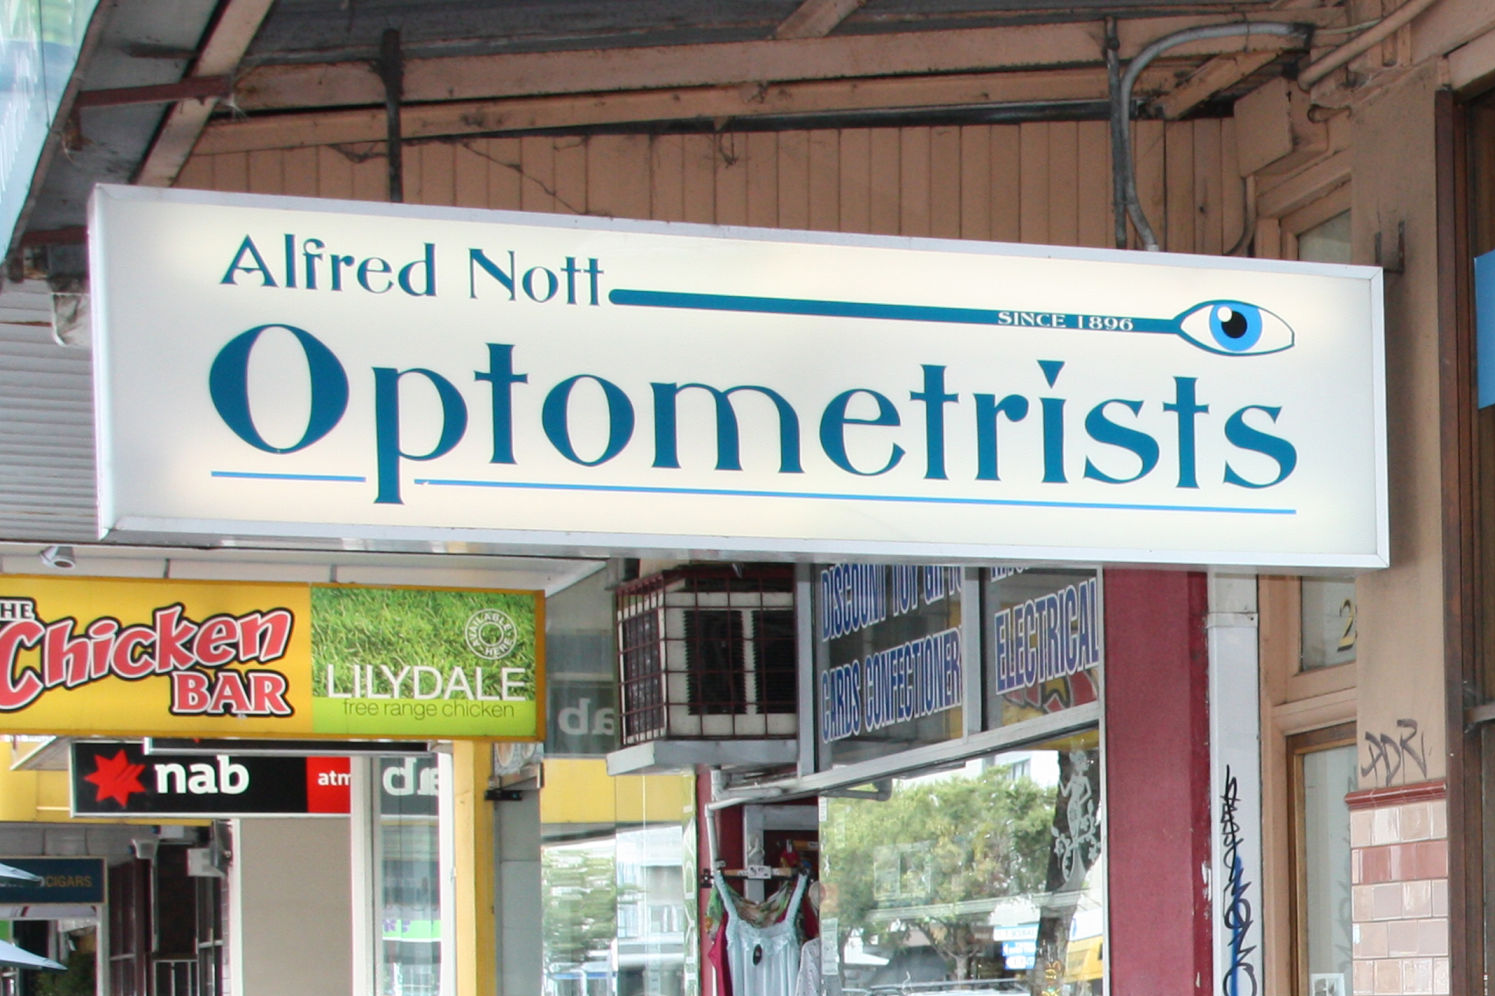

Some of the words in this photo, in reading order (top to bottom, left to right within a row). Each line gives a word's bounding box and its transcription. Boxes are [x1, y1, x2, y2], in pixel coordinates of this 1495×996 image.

[220, 233, 438, 297] Alfred
[469, 248, 604, 306] Nott
[998, 312, 1066, 328] SINCE
[1078, 315, 1134, 331] 1896
[209, 324, 1298, 504] Optometrists
[0, 600, 34, 620] HE
[0, 605, 292, 707] Chicken
[995, 577, 1099, 696] ELECTRICAL
[173, 671, 292, 714] BAR
[327, 664, 526, 701] LILYDALE
[821, 659, 861, 744] CARDS
[865, 626, 962, 733] CONFECTIONER
[343, 699, 379, 716] free
[384, 703, 438, 720] range
[442, 701, 515, 718] chicken
[154, 756, 250, 795] nab
[45, 875, 93, 887] CIGARS
